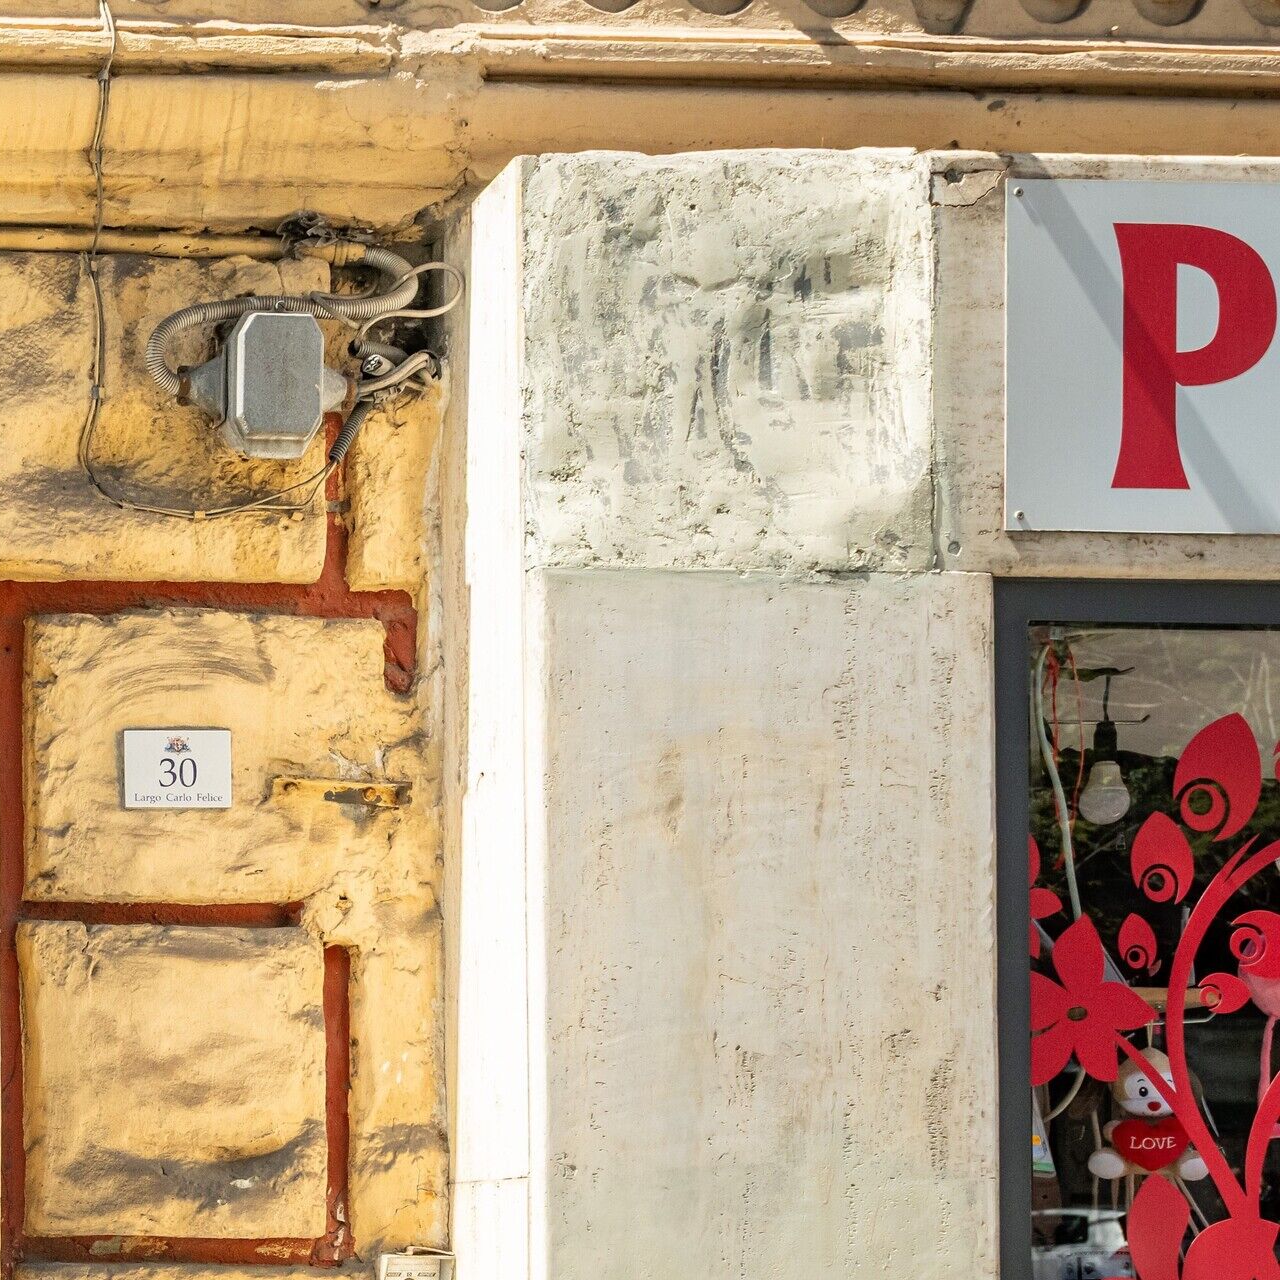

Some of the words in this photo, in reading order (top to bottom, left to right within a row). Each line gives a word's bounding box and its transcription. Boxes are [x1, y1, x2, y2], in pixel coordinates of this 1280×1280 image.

[1110, 222, 1278, 490] P
[158, 757, 198, 788] 30
[134, 793, 162, 804] Largo
[165, 793, 192, 802] Carlo
[196, 793, 223, 802] Felice
[1129, 1136, 1177, 1150] LOVE
